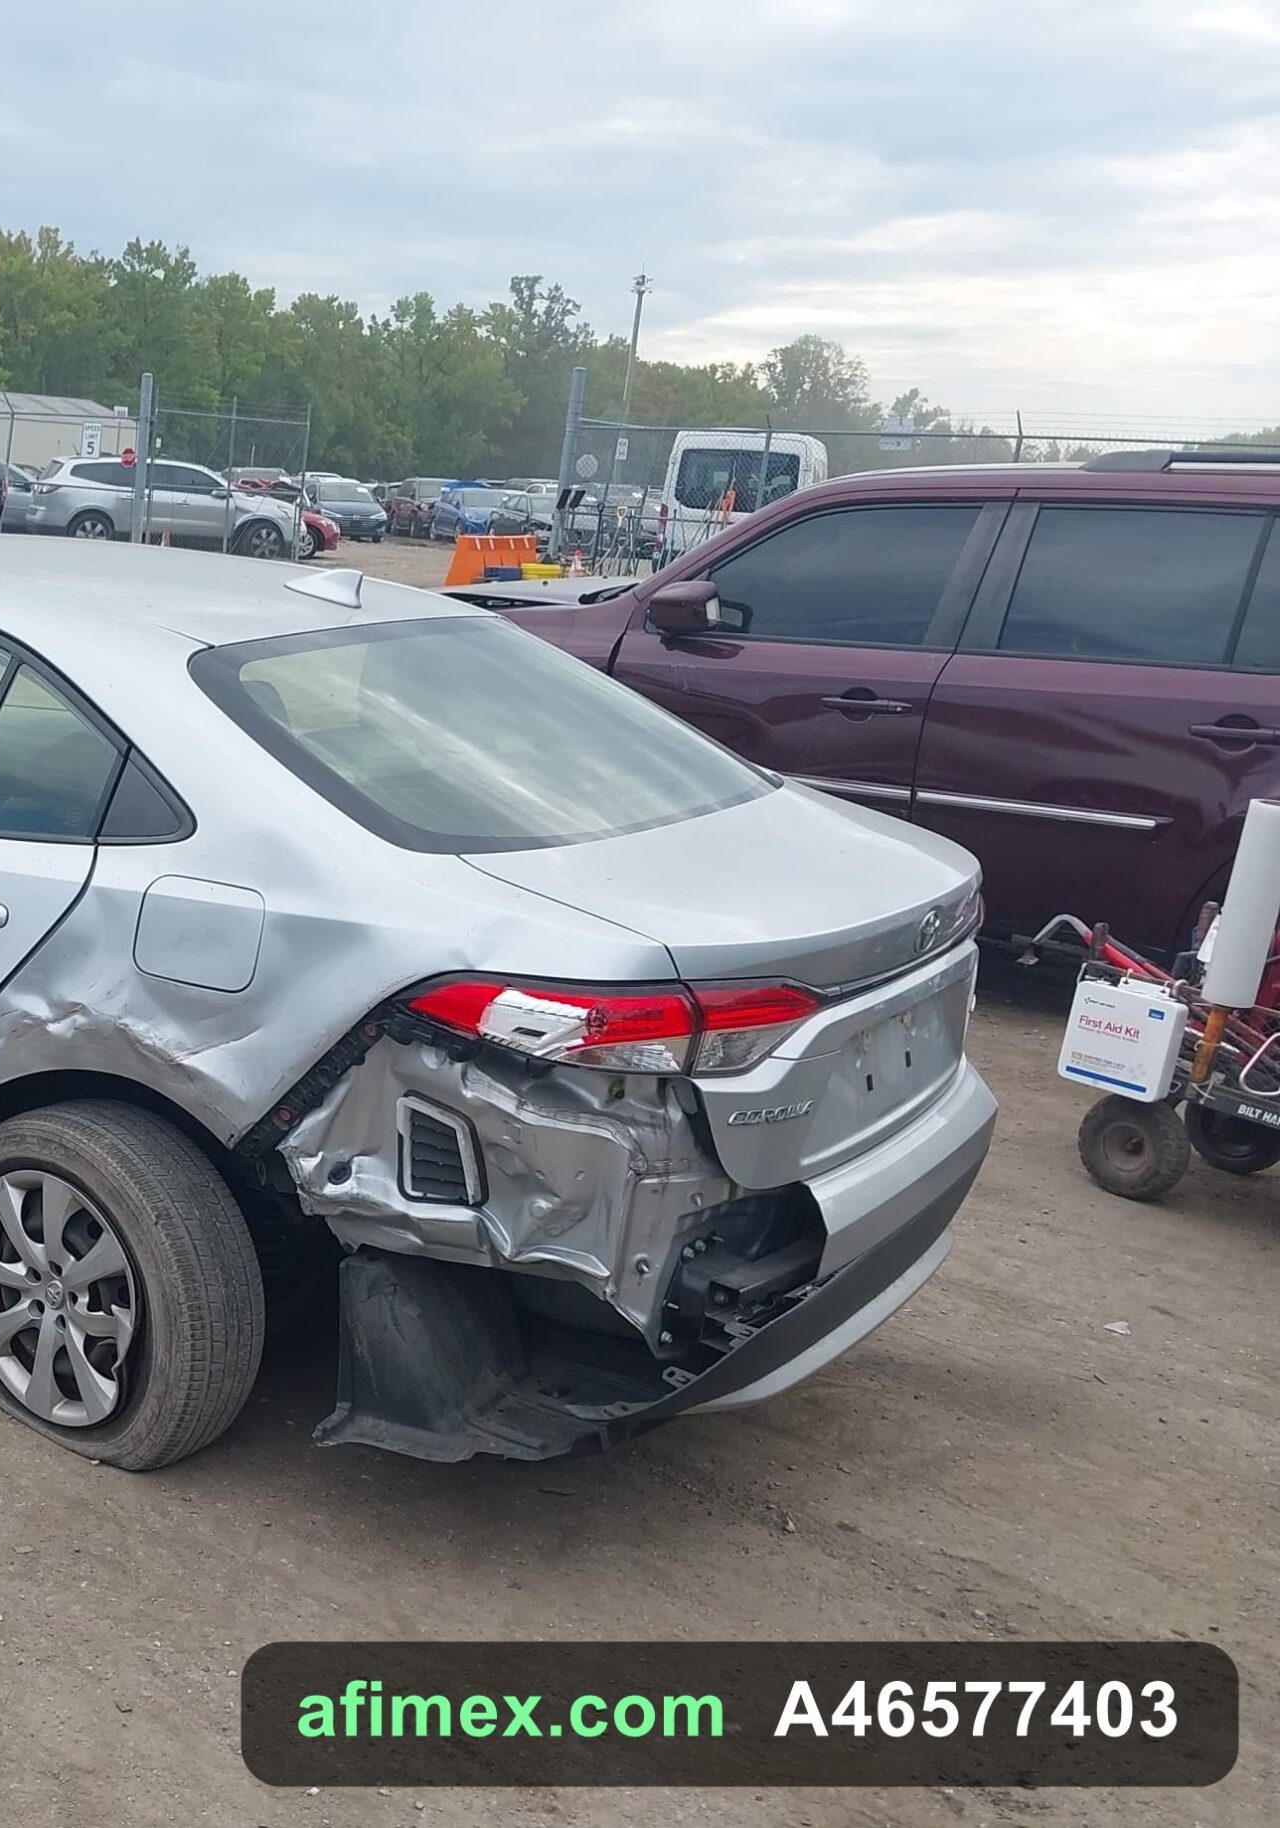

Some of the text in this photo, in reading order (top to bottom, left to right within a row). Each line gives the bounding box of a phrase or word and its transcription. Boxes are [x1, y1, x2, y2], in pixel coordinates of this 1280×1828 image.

[87, 441, 95, 455] 5
[1079, 1015, 1103, 1029] First
[1104, 1021, 1123, 1034] Aid
[1124, 1026, 1141, 1038] Kit
[728, 1099, 815, 1124] COROLLA
[1237, 1103, 1262, 1119] BILT
